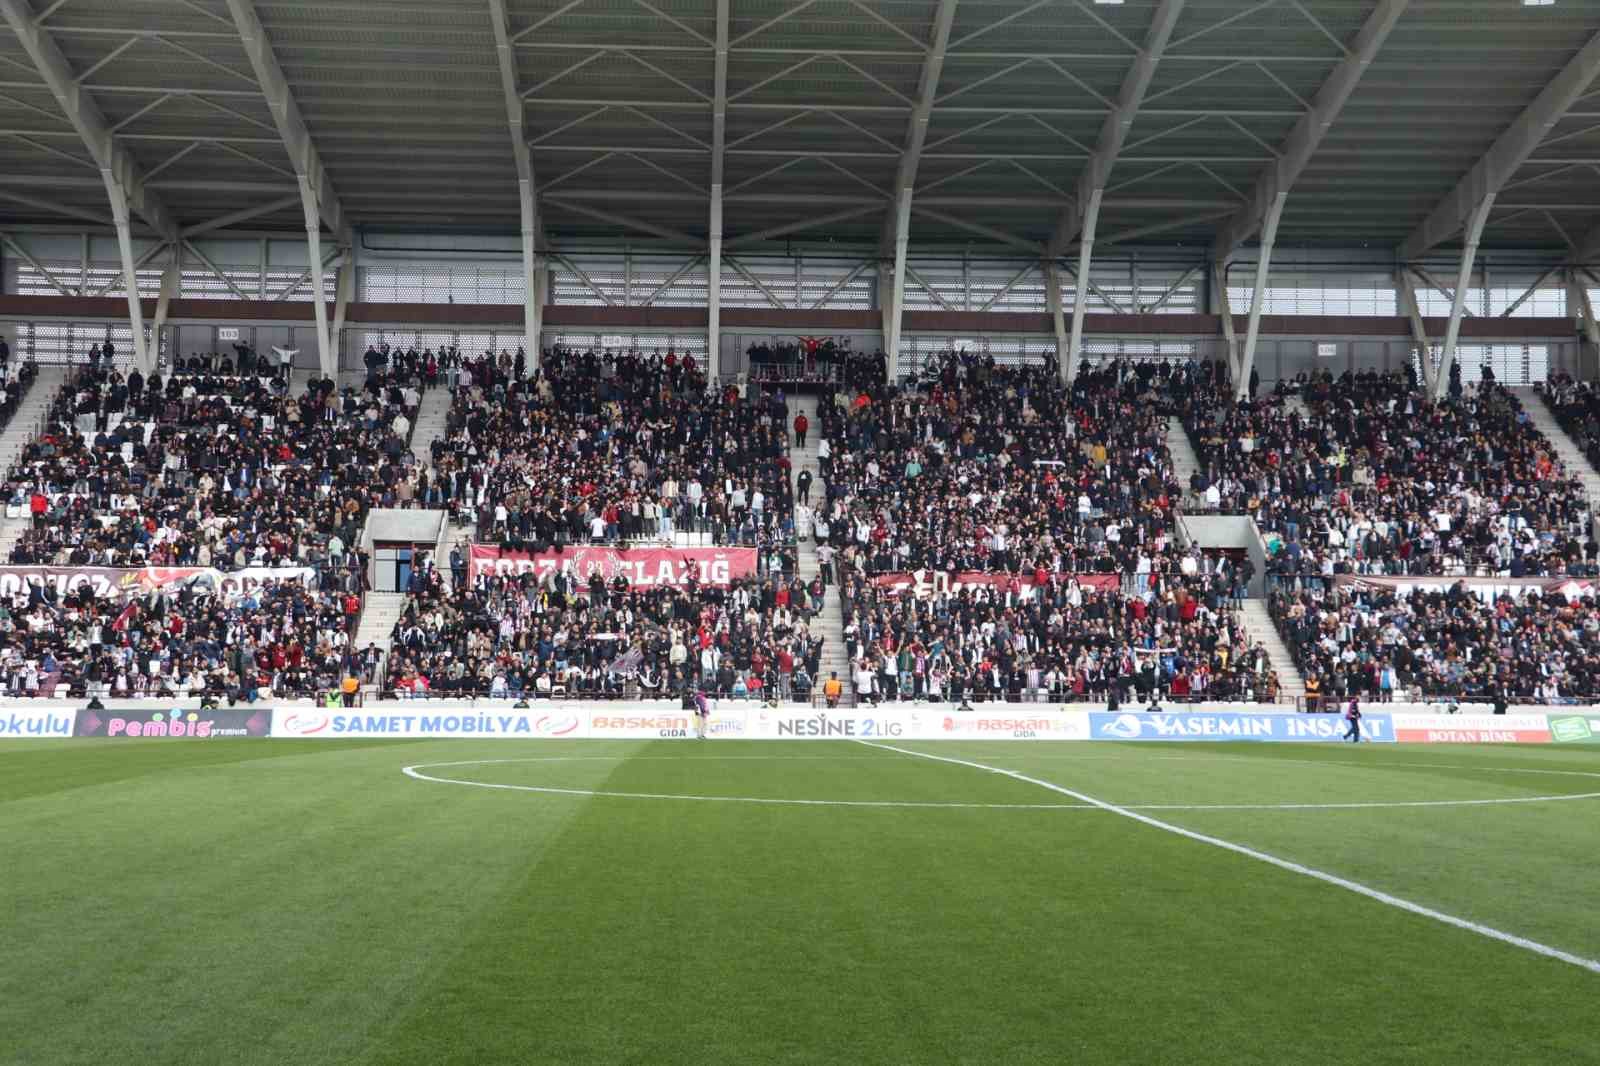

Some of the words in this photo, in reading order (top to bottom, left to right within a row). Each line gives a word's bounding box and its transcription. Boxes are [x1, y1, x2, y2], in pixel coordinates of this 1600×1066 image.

[332, 715, 416, 732] SAMET
[420, 711, 531, 732] MOBİLYA
[659, 729, 687, 737] GIDA
